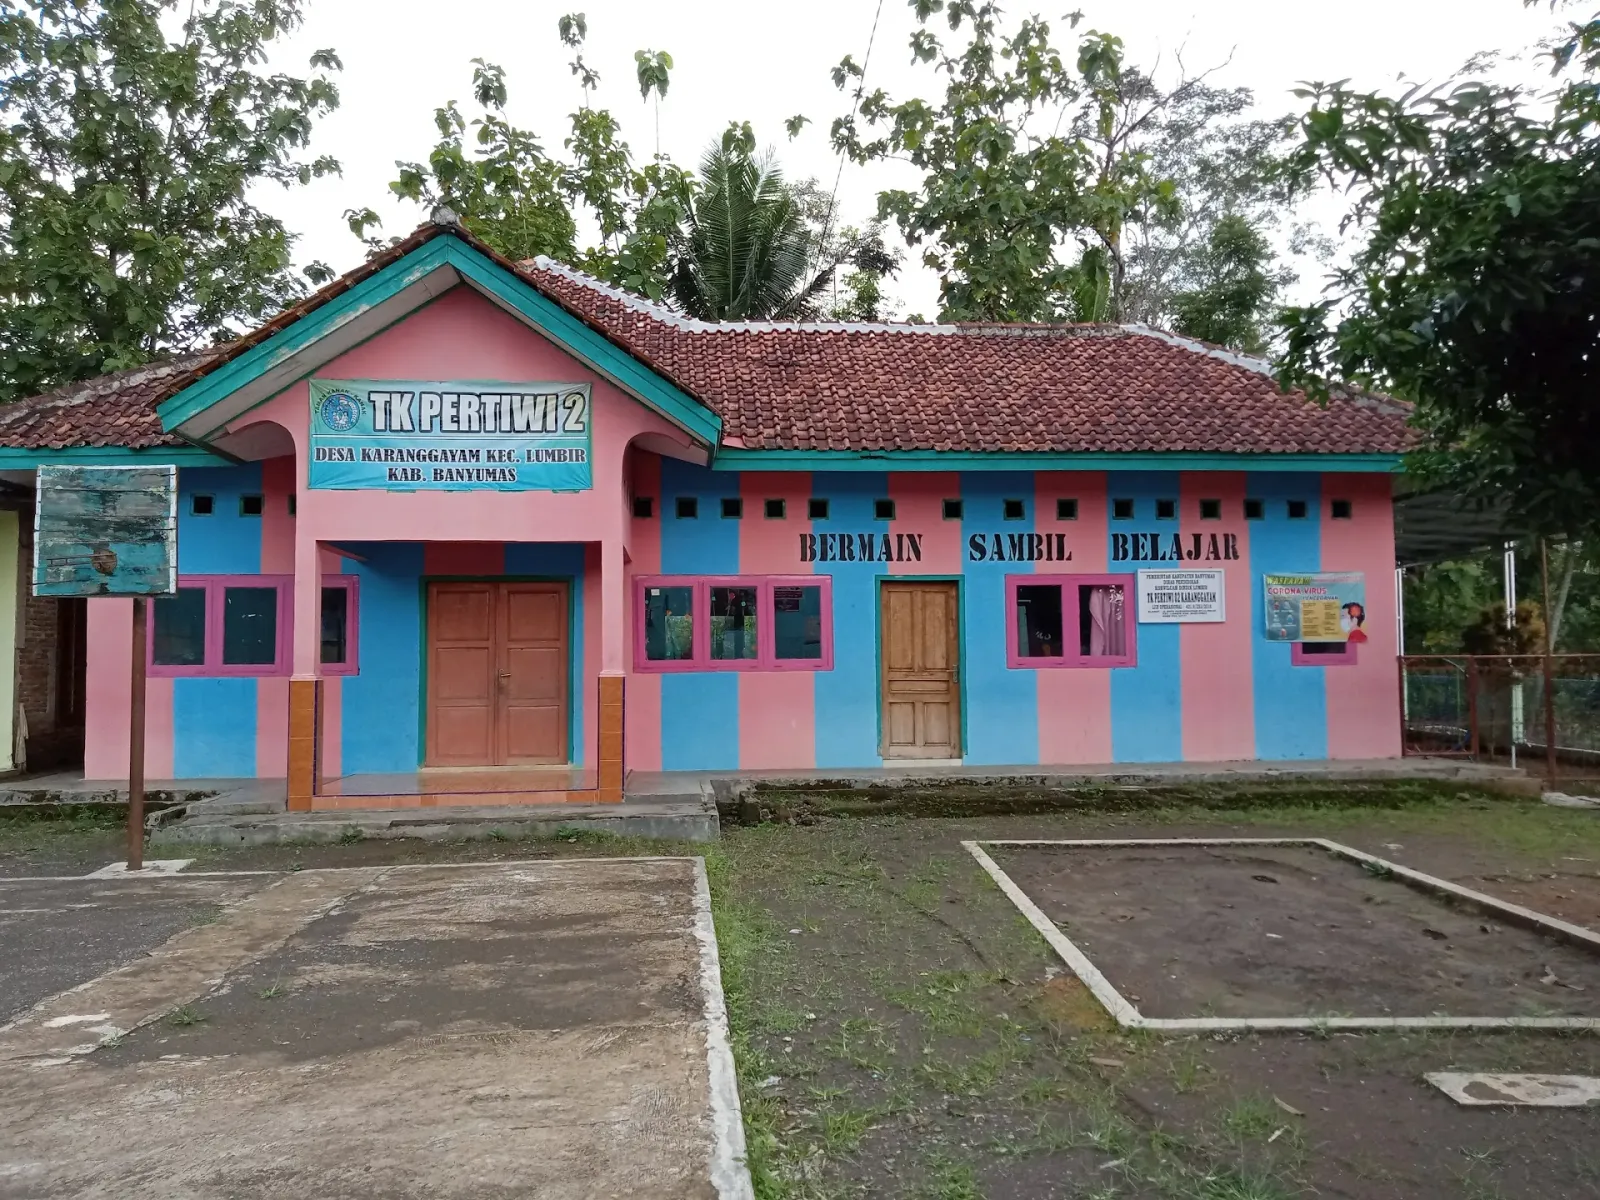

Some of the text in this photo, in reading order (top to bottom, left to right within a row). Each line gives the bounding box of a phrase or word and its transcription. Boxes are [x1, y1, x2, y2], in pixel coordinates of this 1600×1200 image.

[369, 391, 416, 433] TK
[420, 392, 558, 434] PERTIWI
[563, 392, 586, 433] 2
[314, 447, 586, 463] DESA KARANGGAYAM KEC. LUMBIR
[387, 467, 516, 482] KAB. BANYUMAS
[799, 532, 1239, 562] BERMAIN SAMBIL BELAJAR
[1147, 592, 1154, 603] TK
[1154, 592, 1174, 603] PERTIWI
[1181, 592, 1216, 603] KARANGGAYAM
[1267, 587, 1327, 595] CORONA VIRUS
